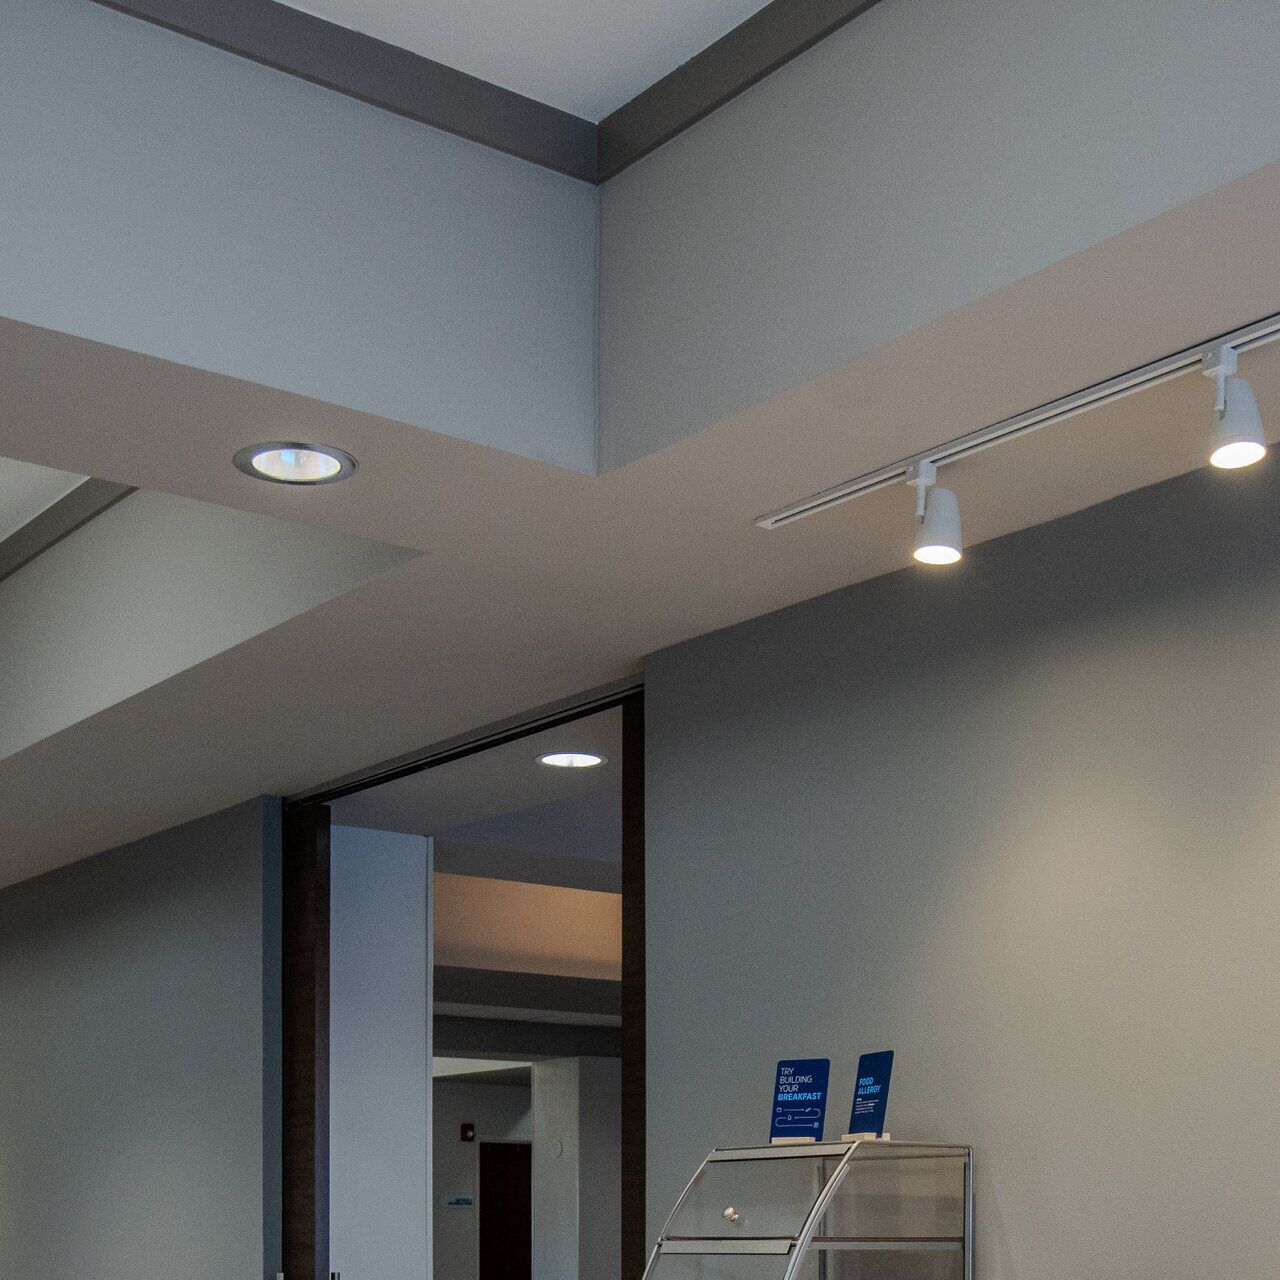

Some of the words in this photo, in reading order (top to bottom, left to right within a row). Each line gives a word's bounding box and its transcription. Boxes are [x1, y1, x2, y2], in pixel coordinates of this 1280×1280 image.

[780, 1067, 795, 1076] TRY
[779, 1075, 813, 1084] BUILDING
[858, 1077, 874, 1086] FOOD
[778, 1084, 799, 1093] YOUR
[857, 1084, 882, 1095] ALLERGY
[777, 1092, 822, 1101] BREAKFAST
